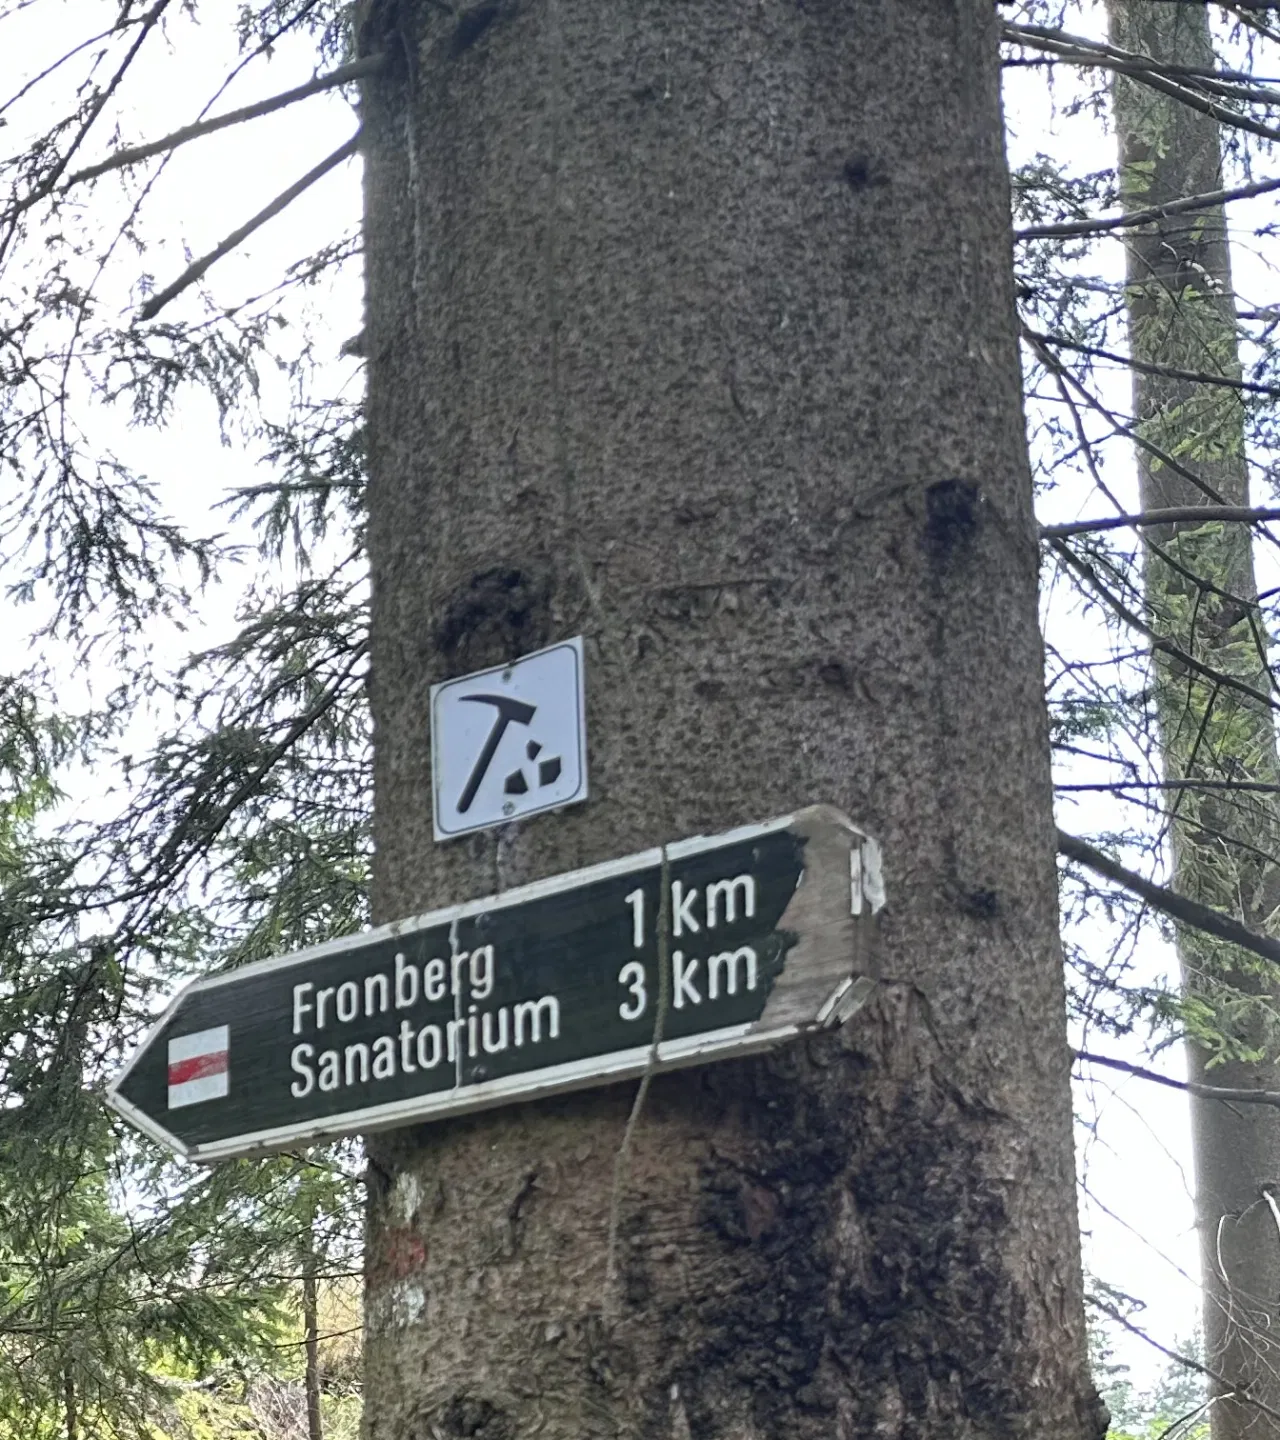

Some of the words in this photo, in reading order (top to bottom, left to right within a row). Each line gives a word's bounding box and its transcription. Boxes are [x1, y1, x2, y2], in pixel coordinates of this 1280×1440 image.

[290, 995, 561, 1098] Sanatorium
[618, 961, 647, 1021] 3
[672, 945, 758, 1008] km
[291, 943, 495, 1034] Fronberg
[624, 888, 645, 948] 1
[672, 874, 756, 937] km
